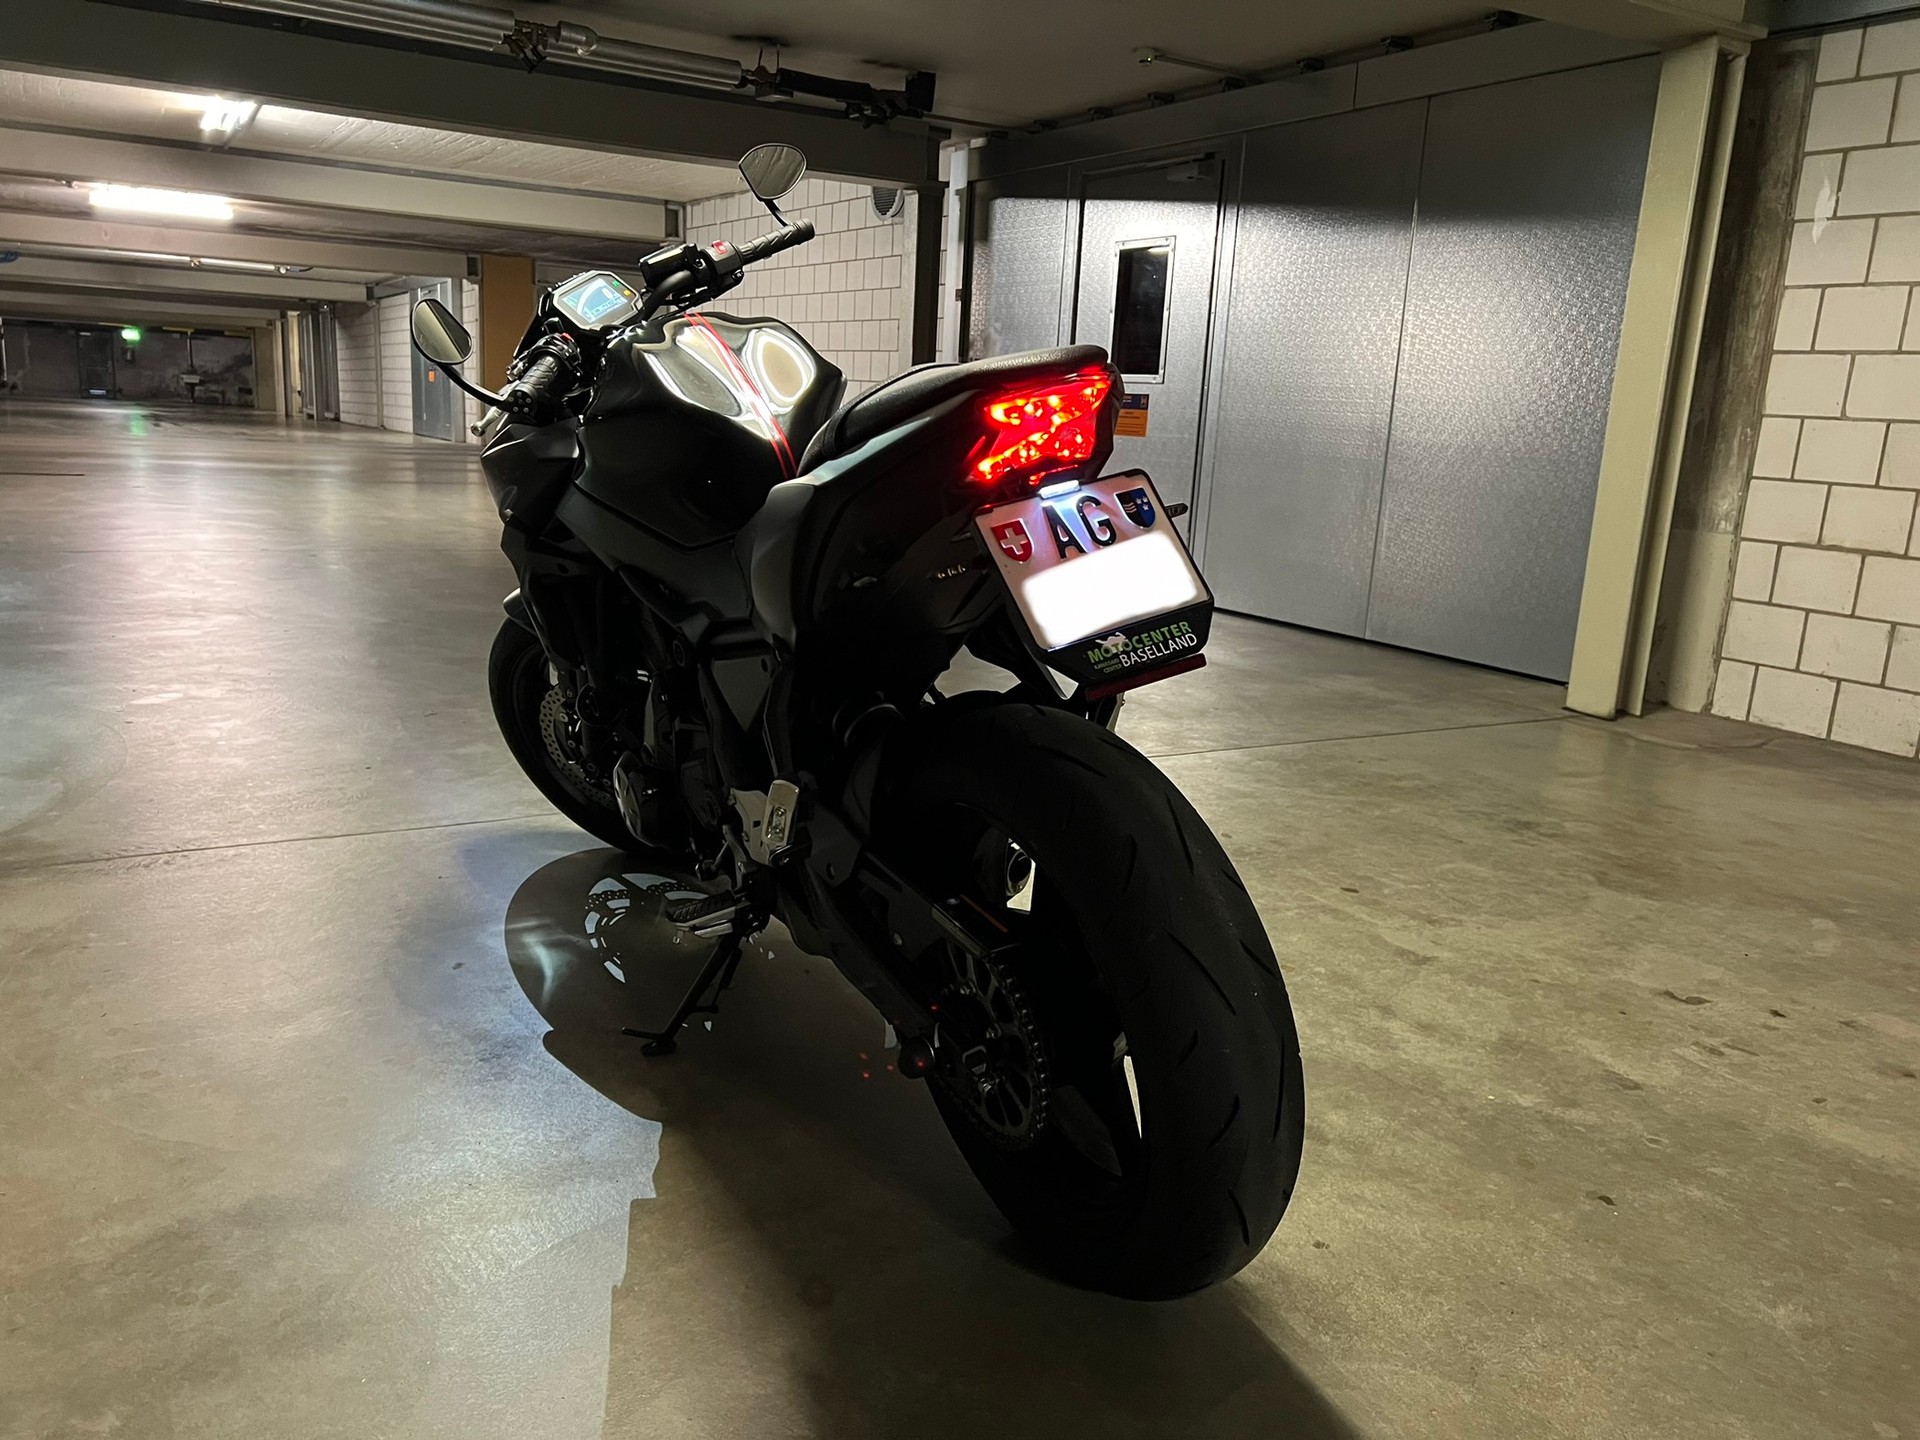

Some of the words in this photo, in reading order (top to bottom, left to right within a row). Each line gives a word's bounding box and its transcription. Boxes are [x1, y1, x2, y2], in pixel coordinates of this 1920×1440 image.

[1043, 495, 1117, 559] AG
[1087, 621, 1192, 664] MOTOCENTER
[1119, 633, 1198, 667] BASELLAND
